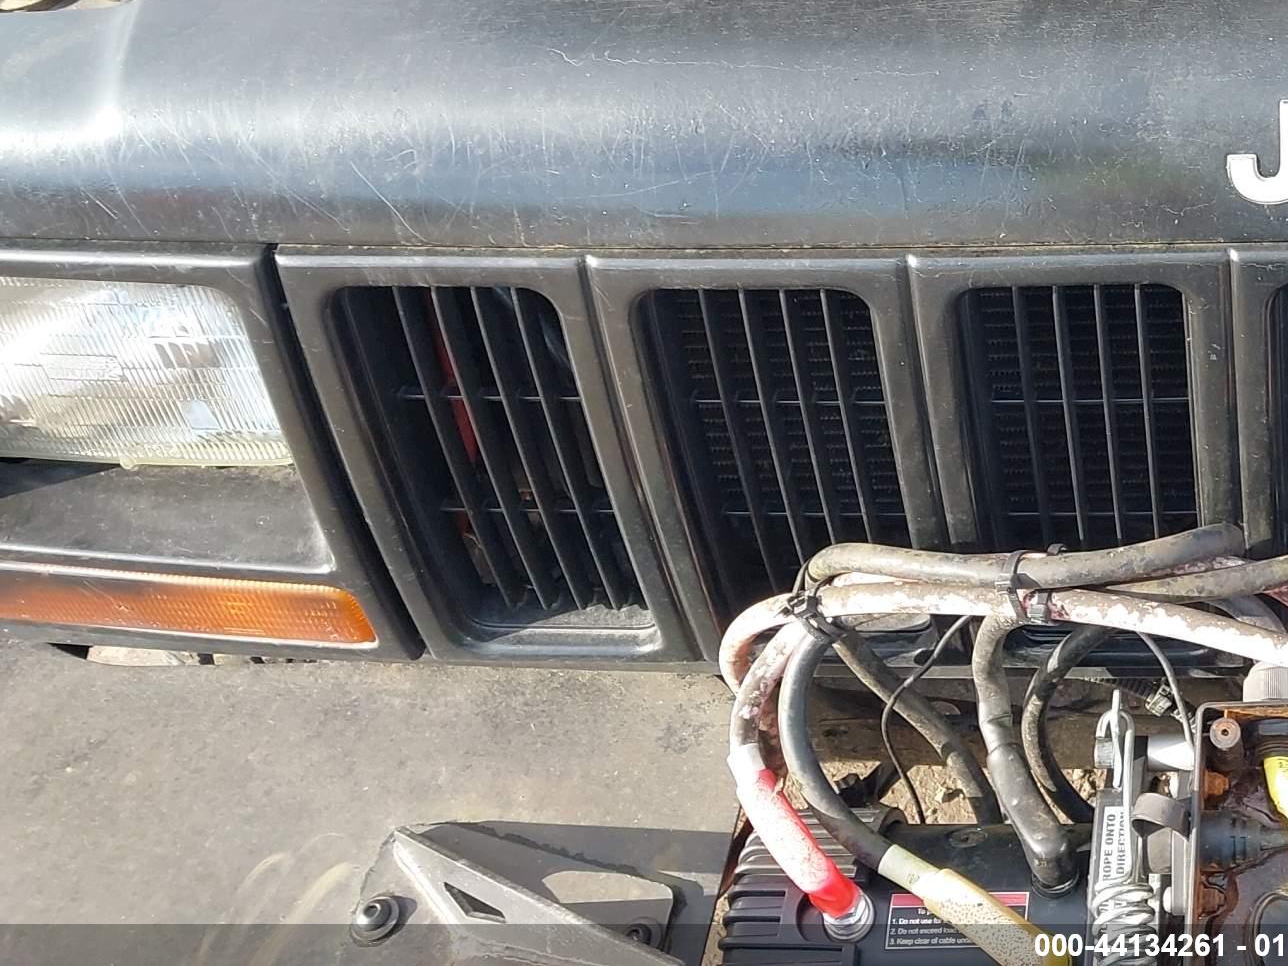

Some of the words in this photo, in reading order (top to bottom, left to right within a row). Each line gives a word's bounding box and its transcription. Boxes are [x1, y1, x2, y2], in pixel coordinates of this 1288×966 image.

[1105, 813, 1116, 846] ONTO
[919, 927, 943, 935] exceed
[896, 938, 914, 946] Keep
[938, 936, 956, 944] cable
